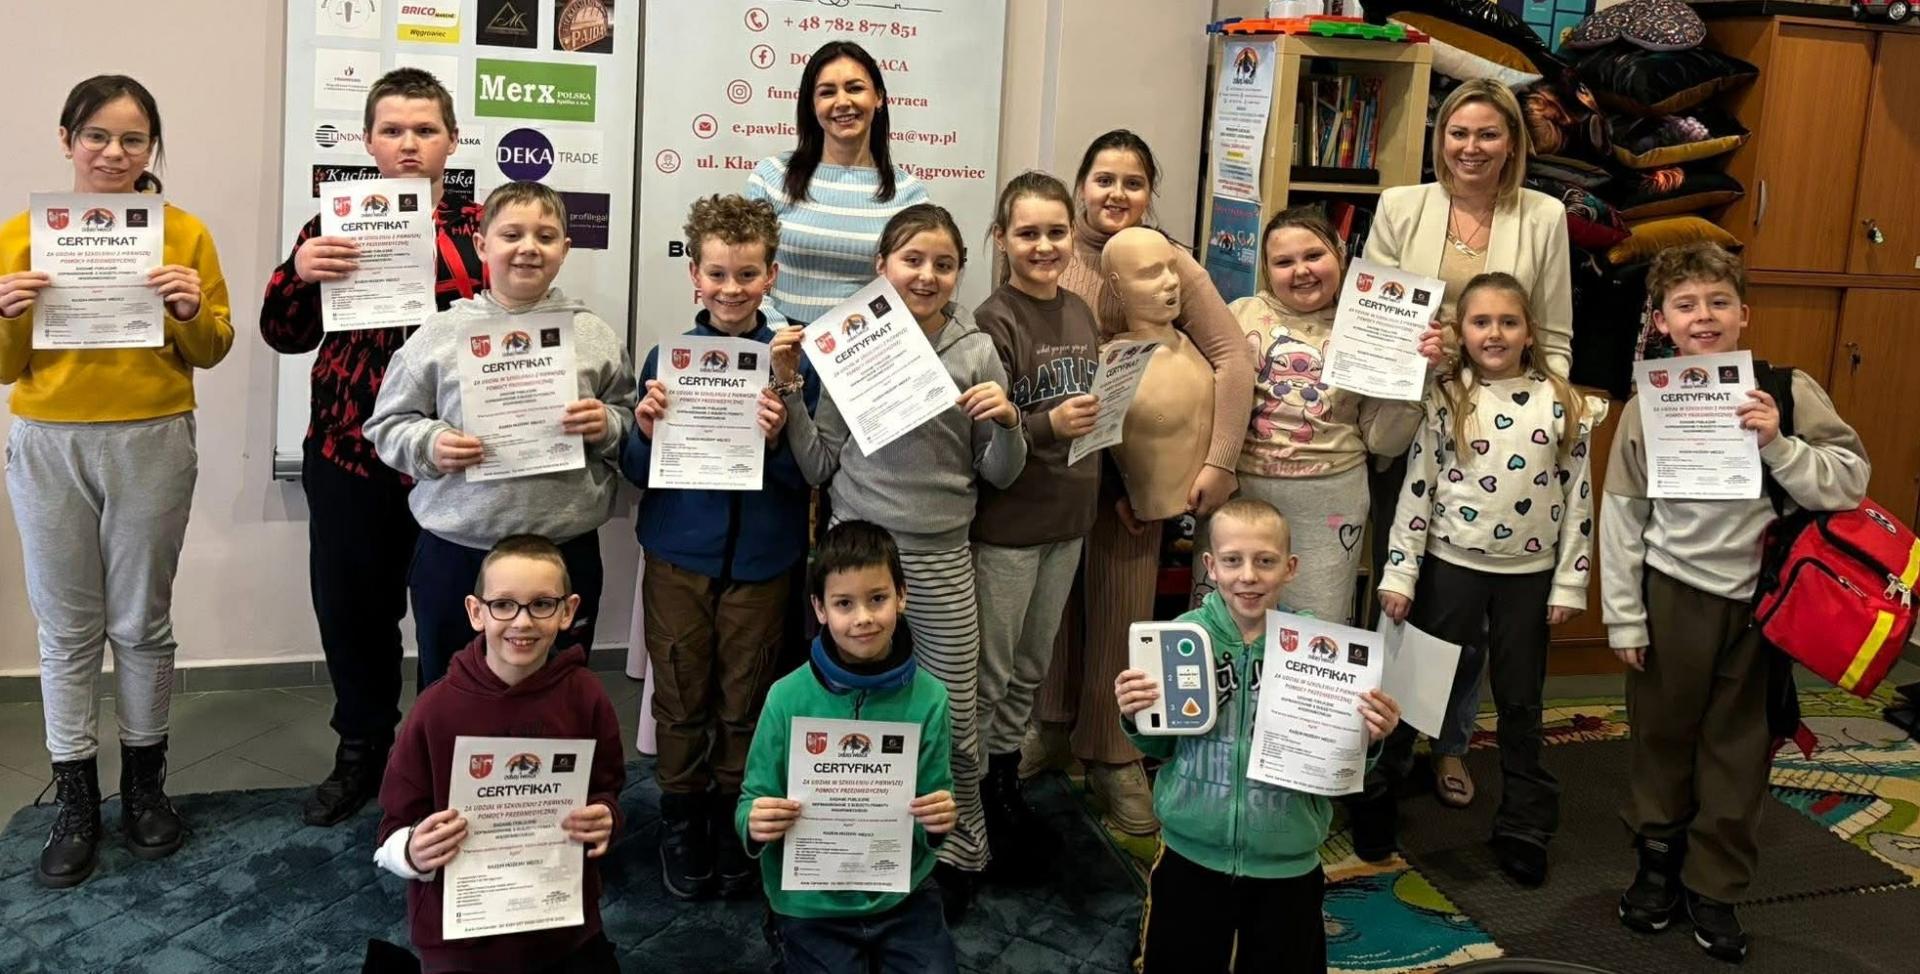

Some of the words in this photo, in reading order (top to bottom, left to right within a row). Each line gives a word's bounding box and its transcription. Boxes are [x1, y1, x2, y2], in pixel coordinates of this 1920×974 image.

[401, 5, 436, 16] BRICO
[798, 16, 820, 31] 48
[825, 19, 854, 32] 782
[859, 19, 887, 36] 877
[890, 22, 917, 38] 851
[790, 53, 812, 66] DO
[880, 59, 909, 72] ACA
[479, 73, 555, 104] Merx
[557, 91, 591, 100] POLSKA
[767, 86, 800, 100] fund
[331, 132, 362, 141] LINDN
[457, 137, 481, 146] LSKA
[732, 123, 798, 136] e.pawlic
[889, 130, 957, 146] ca@wp.pl
[497, 146, 553, 165] DEKA
[558, 151, 599, 164] TRADE
[697, 155, 719, 169] ul.
[899, 163, 986, 180] Wągrowiec
[341, 220, 410, 232] CERTYFIKAT
[57, 236, 138, 246] CERTYFIKAT
[1358, 298, 1419, 319] CERTYFIKAT
[834, 322, 893, 364] CERTYFIKAT
[482, 356, 553, 374] CERTYFIKAT
[678, 376, 747, 388] CERTYFIKAT
[1661, 392, 1731, 403] CERTYFIKAT
[1285, 660, 1357, 684] CERTYFIKAT
[813, 763, 892, 774] CERTYFIKAT
[477, 783, 562, 798] CERTYFIKAT
